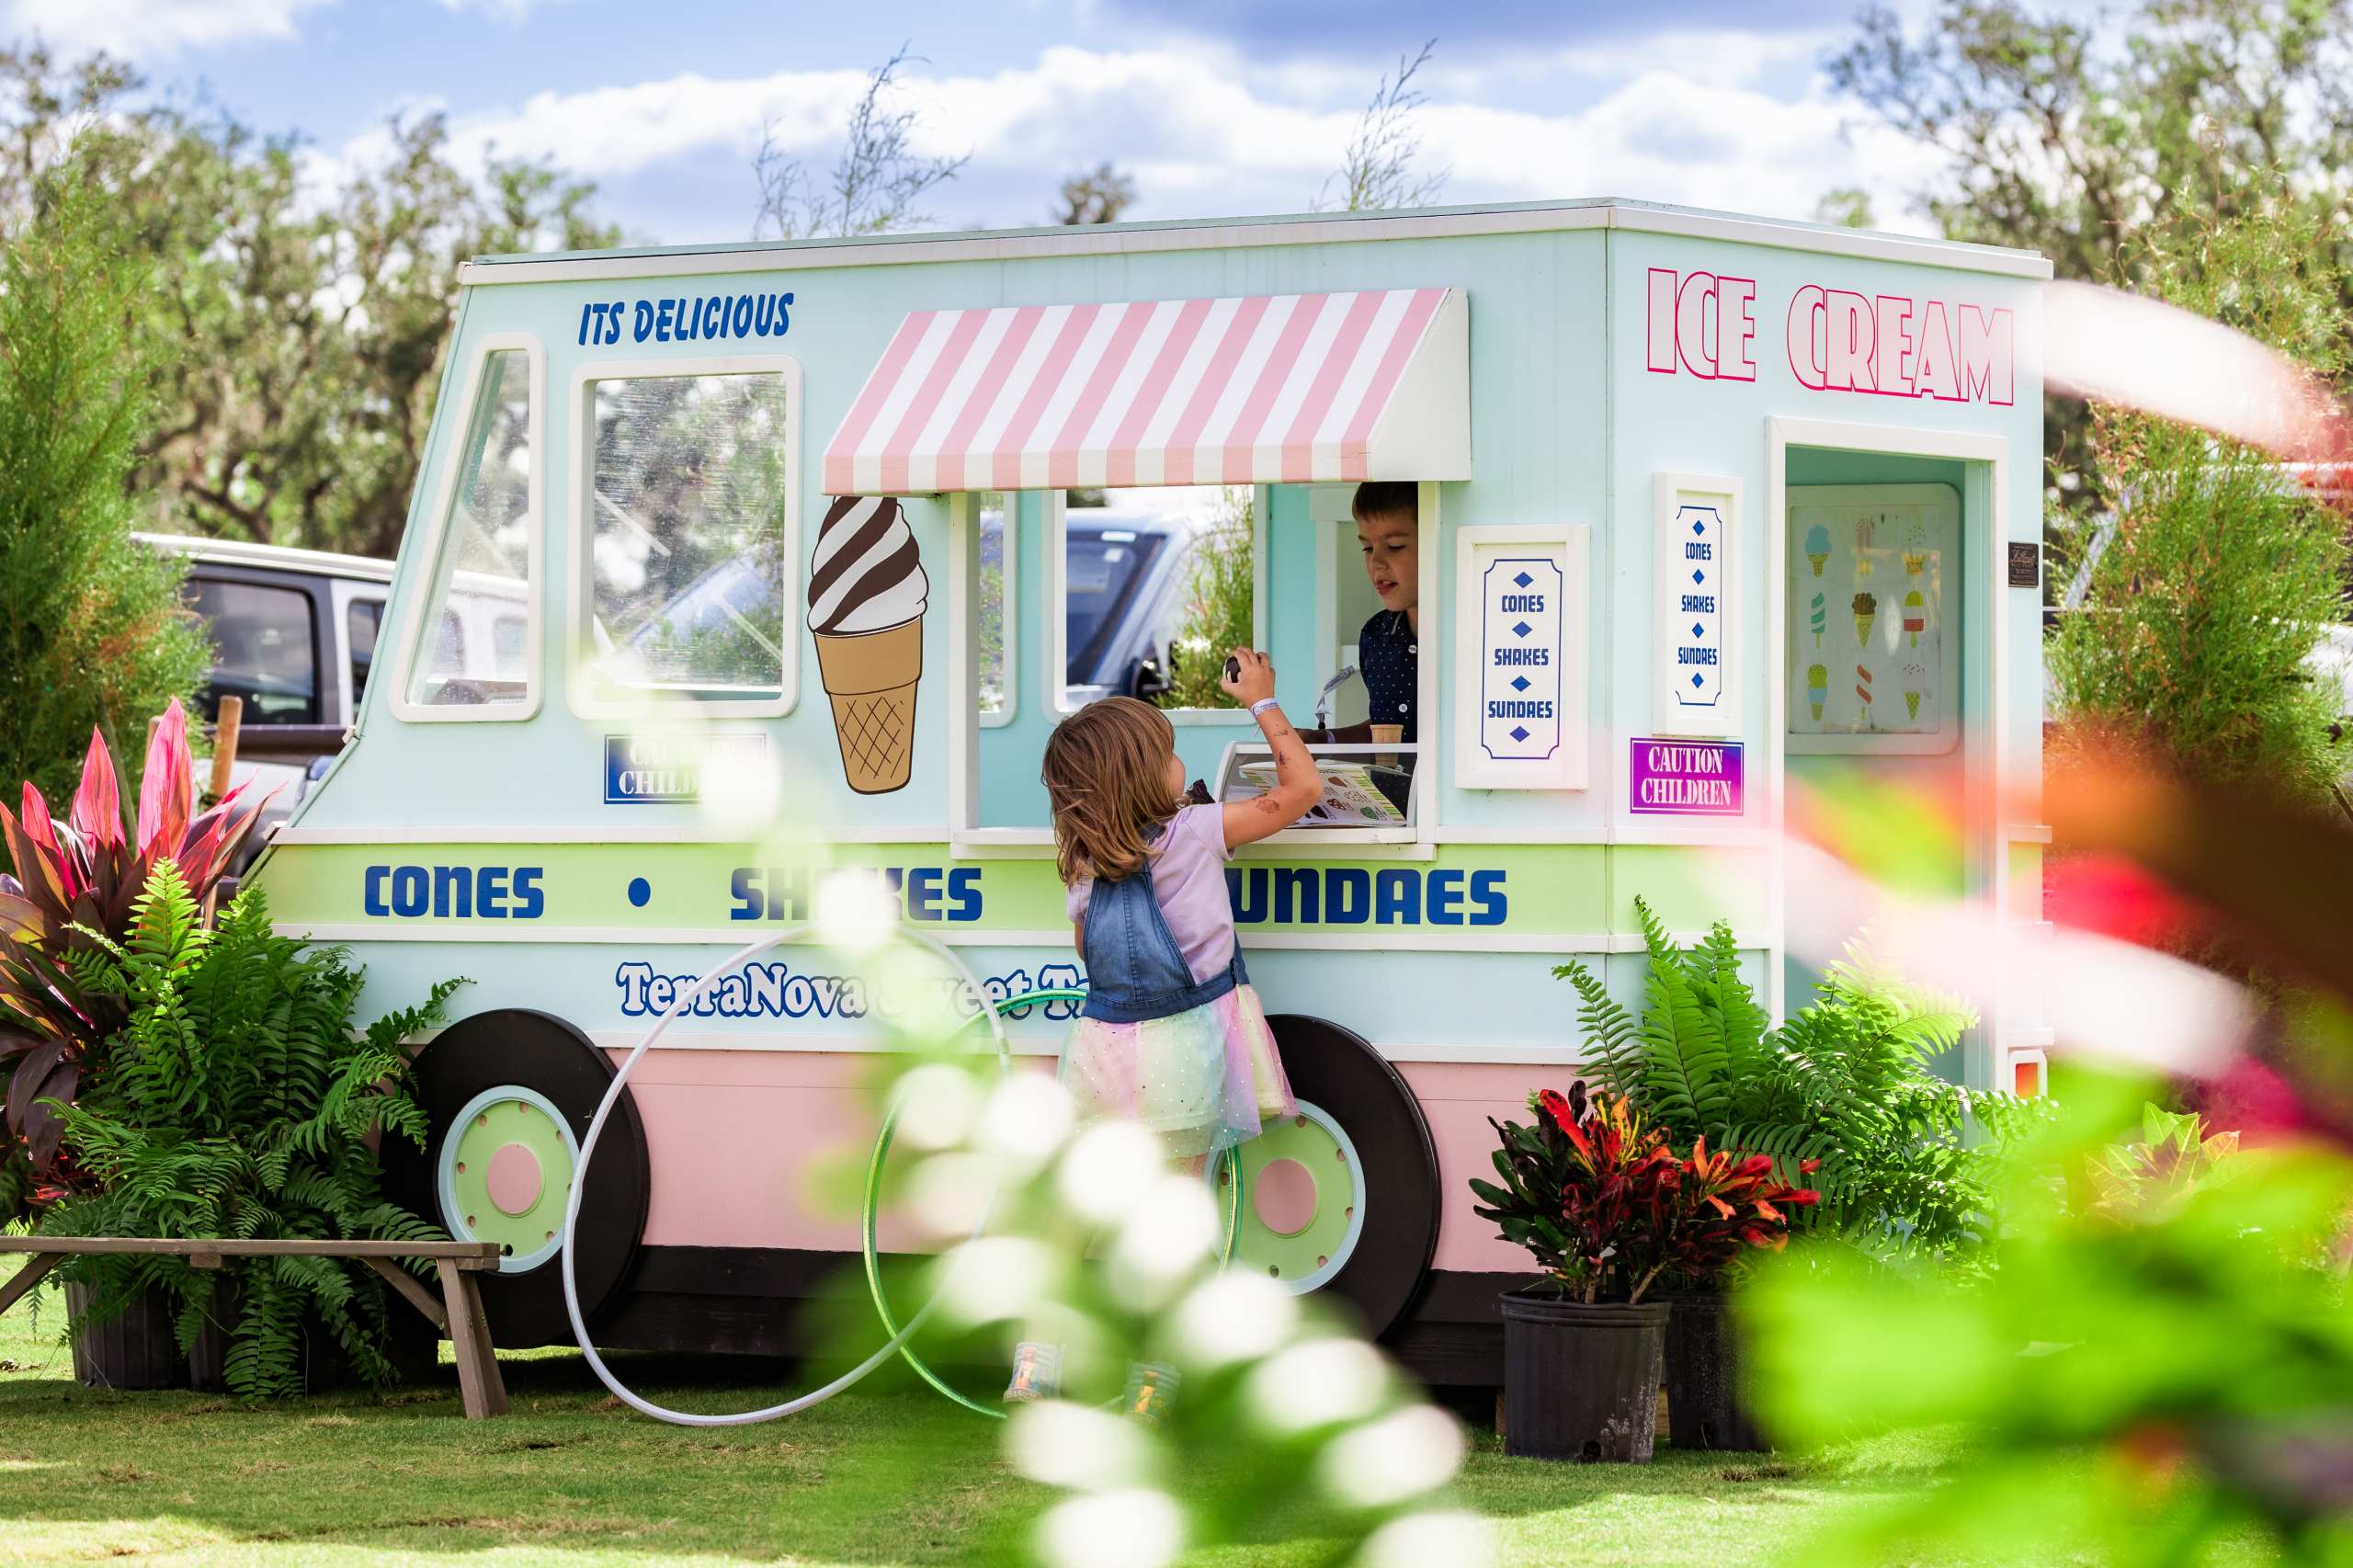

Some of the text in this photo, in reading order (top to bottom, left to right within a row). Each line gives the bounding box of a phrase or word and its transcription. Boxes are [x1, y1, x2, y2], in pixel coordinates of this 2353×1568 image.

[578, 292, 794, 346] ITS DELICIOUS
[1647, 267, 2015, 406] ICE CREAM
[1685, 541, 1711, 561] CONES
[1501, 595, 1545, 613] CONES
[1681, 595, 1715, 614] SHAKES
[1494, 648, 1550, 666] SHAKES
[1677, 646, 1718, 665] SUNDAES
[1488, 700, 1553, 719] SUNDAES
[1648, 746, 1723, 774] CAUTION
[1641, 778, 1732, 805] CHILDREN
[364, 866, 544, 919] CONES
[730, 867, 983, 922] SHES
[1224, 868, 1508, 926] UNDAES
[615, 961, 870, 1019] TerraNova
